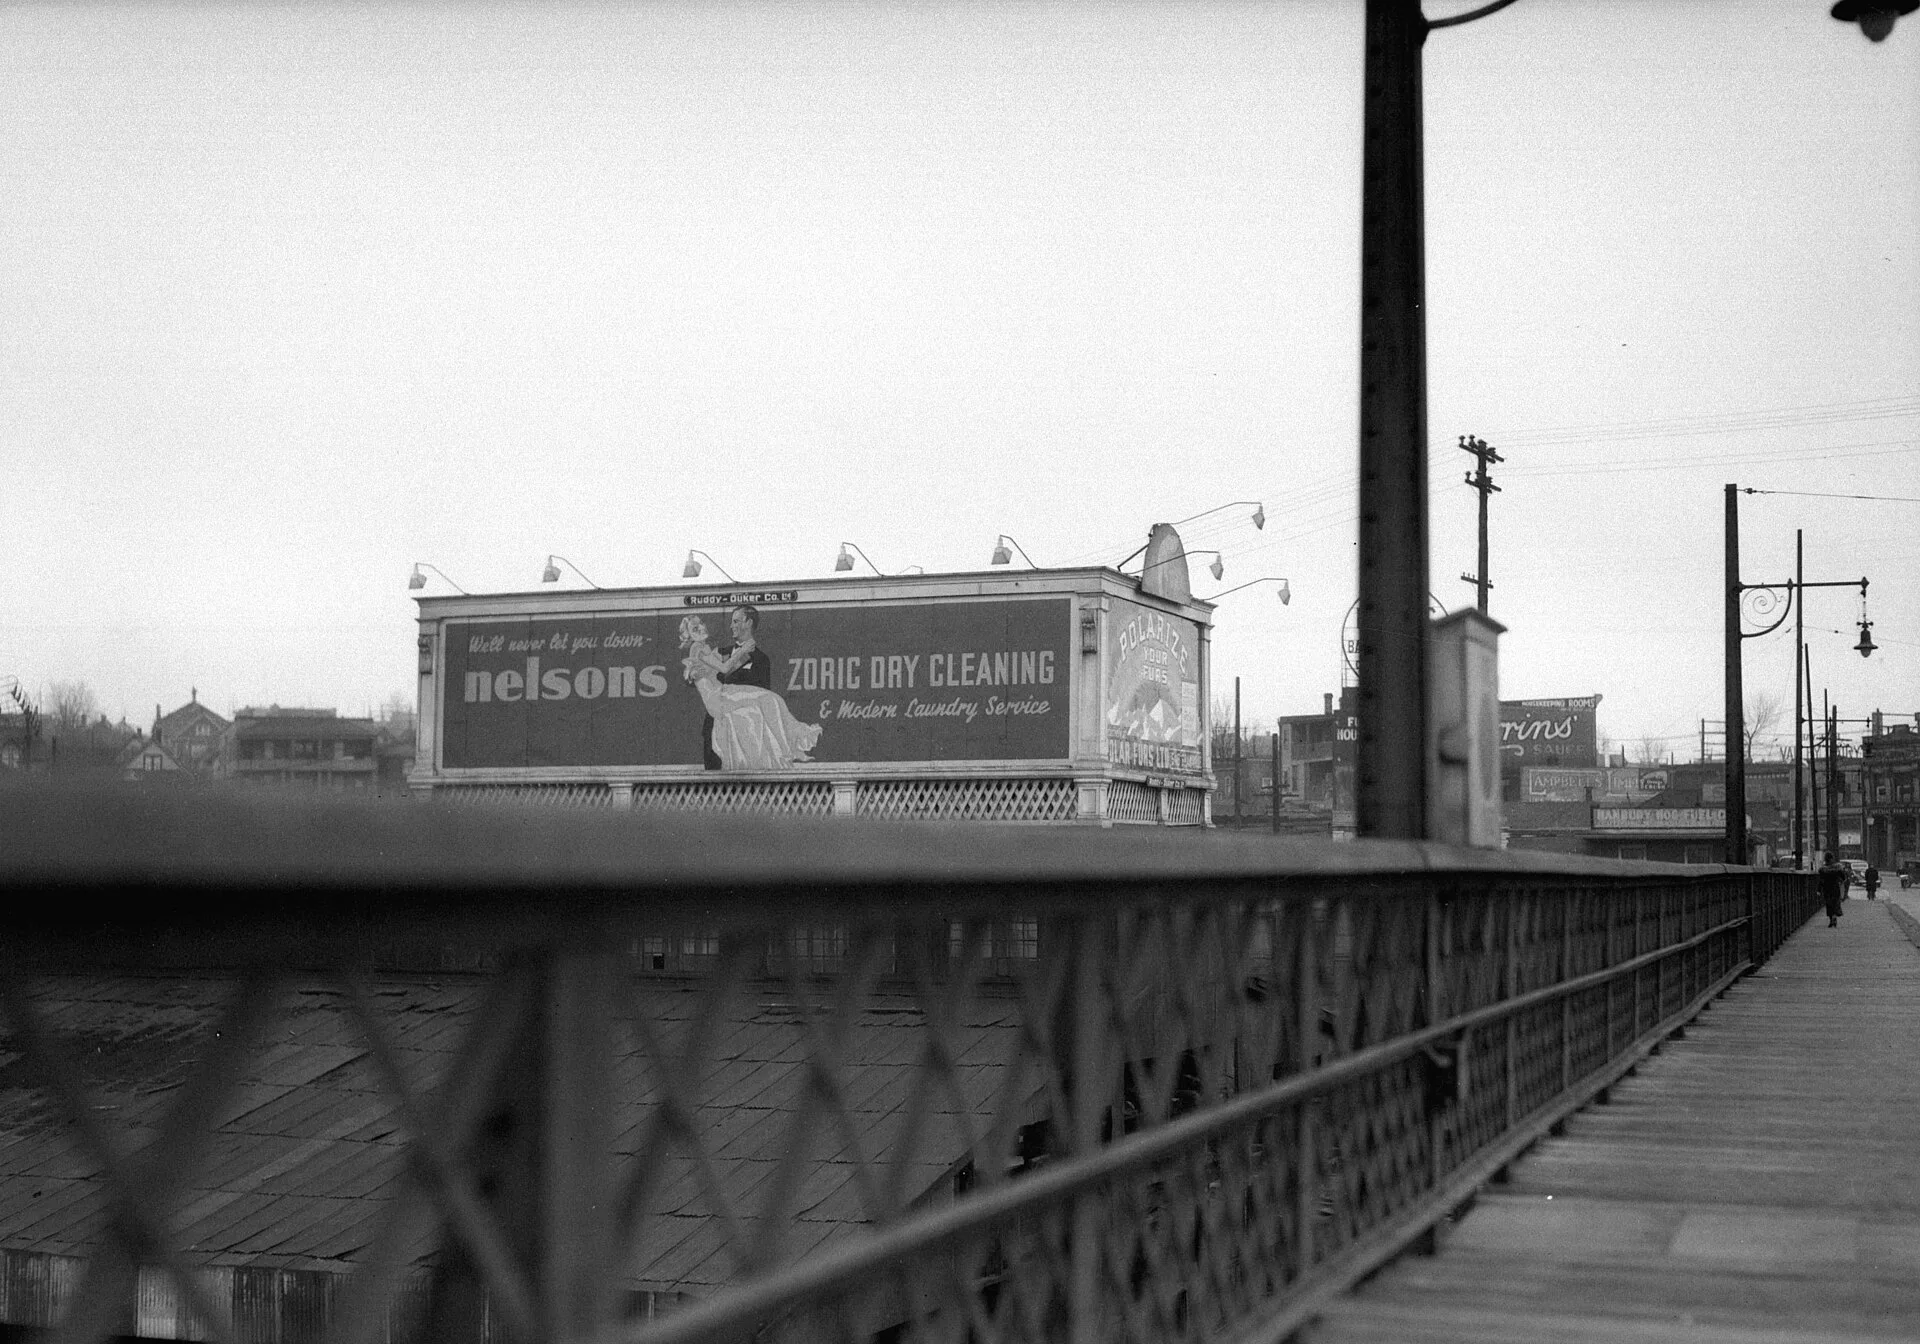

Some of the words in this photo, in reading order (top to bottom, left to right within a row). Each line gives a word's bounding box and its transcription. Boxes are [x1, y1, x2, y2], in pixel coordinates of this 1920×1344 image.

[508, 638, 546, 652] never
[549, 632, 569, 650] let
[570, 636, 598, 655] you
[1119, 612, 1189, 674] POLARIZE
[1143, 646, 1168, 666] YOUR
[464, 655, 668, 703] nelsons
[787, 655, 861, 691] ZORIC
[870, 654, 920, 689] DRY
[929, 650, 1055, 687] CLEANING
[1142, 664, 1168, 685] FURS
[819, 699, 832, 719] &
[837, 699, 897, 720] Modern
[904, 697, 978, 723] Laundry
[985, 694, 1051, 716] Service
[1568, 698, 1595, 708] ROOMS
[1597, 808, 1650, 821] HANBURY
[1684, 808, 1713, 820] FUEL
